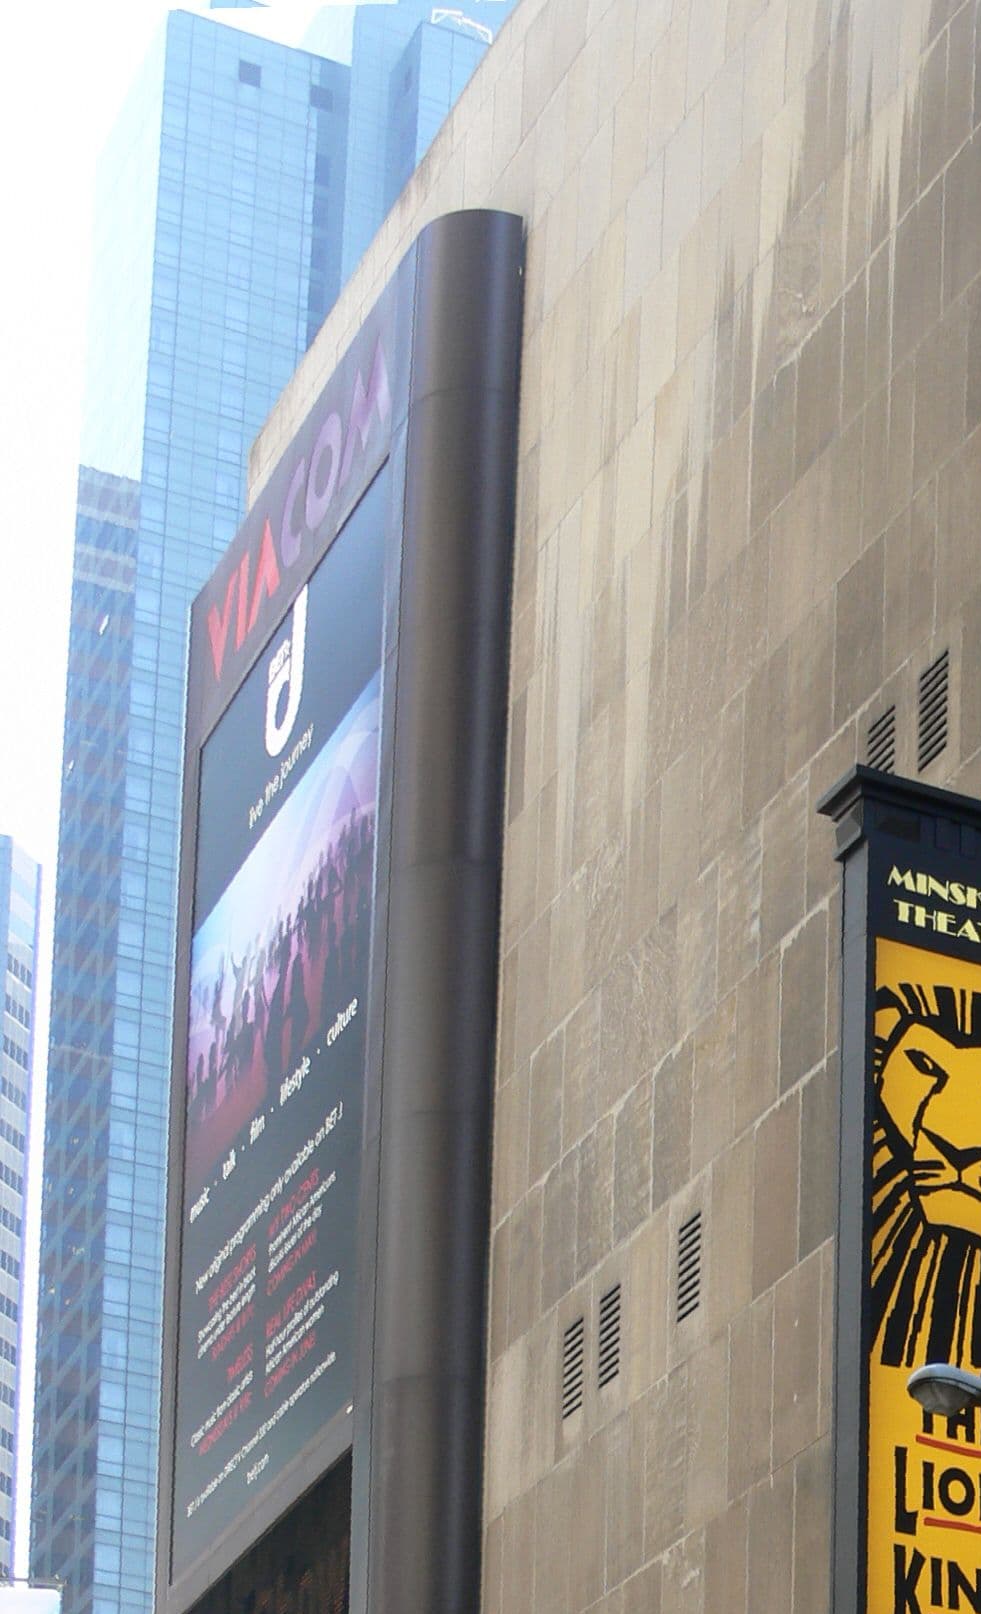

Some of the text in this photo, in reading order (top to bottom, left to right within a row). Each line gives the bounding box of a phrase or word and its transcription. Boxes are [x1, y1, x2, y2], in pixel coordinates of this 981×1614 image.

[207, 336, 391, 682] VIACOM
[265, 776, 279, 806] the
[280, 723, 314, 790] journey
[327, 998, 358, 1046] culture
